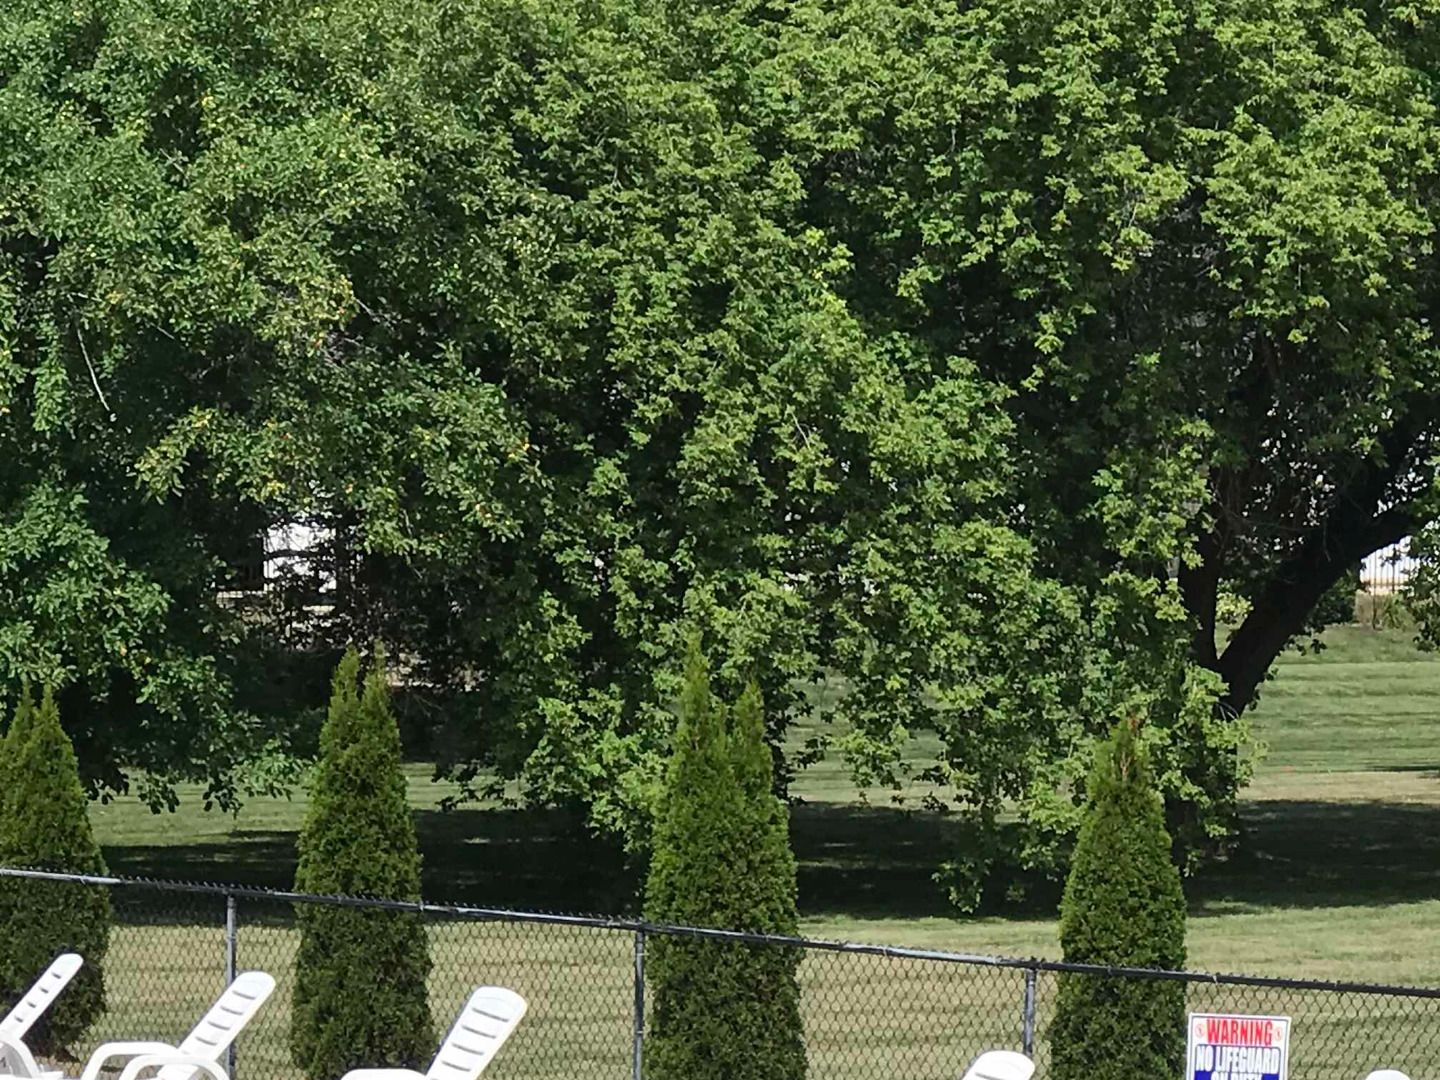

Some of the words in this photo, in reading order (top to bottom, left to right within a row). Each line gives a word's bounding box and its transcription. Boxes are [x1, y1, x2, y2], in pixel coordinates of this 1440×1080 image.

[1207, 1018, 1272, 1045] WARNING
[1196, 1046, 1214, 1071] NO
[1216, 1047, 1280, 1074] LIFEGUARD
